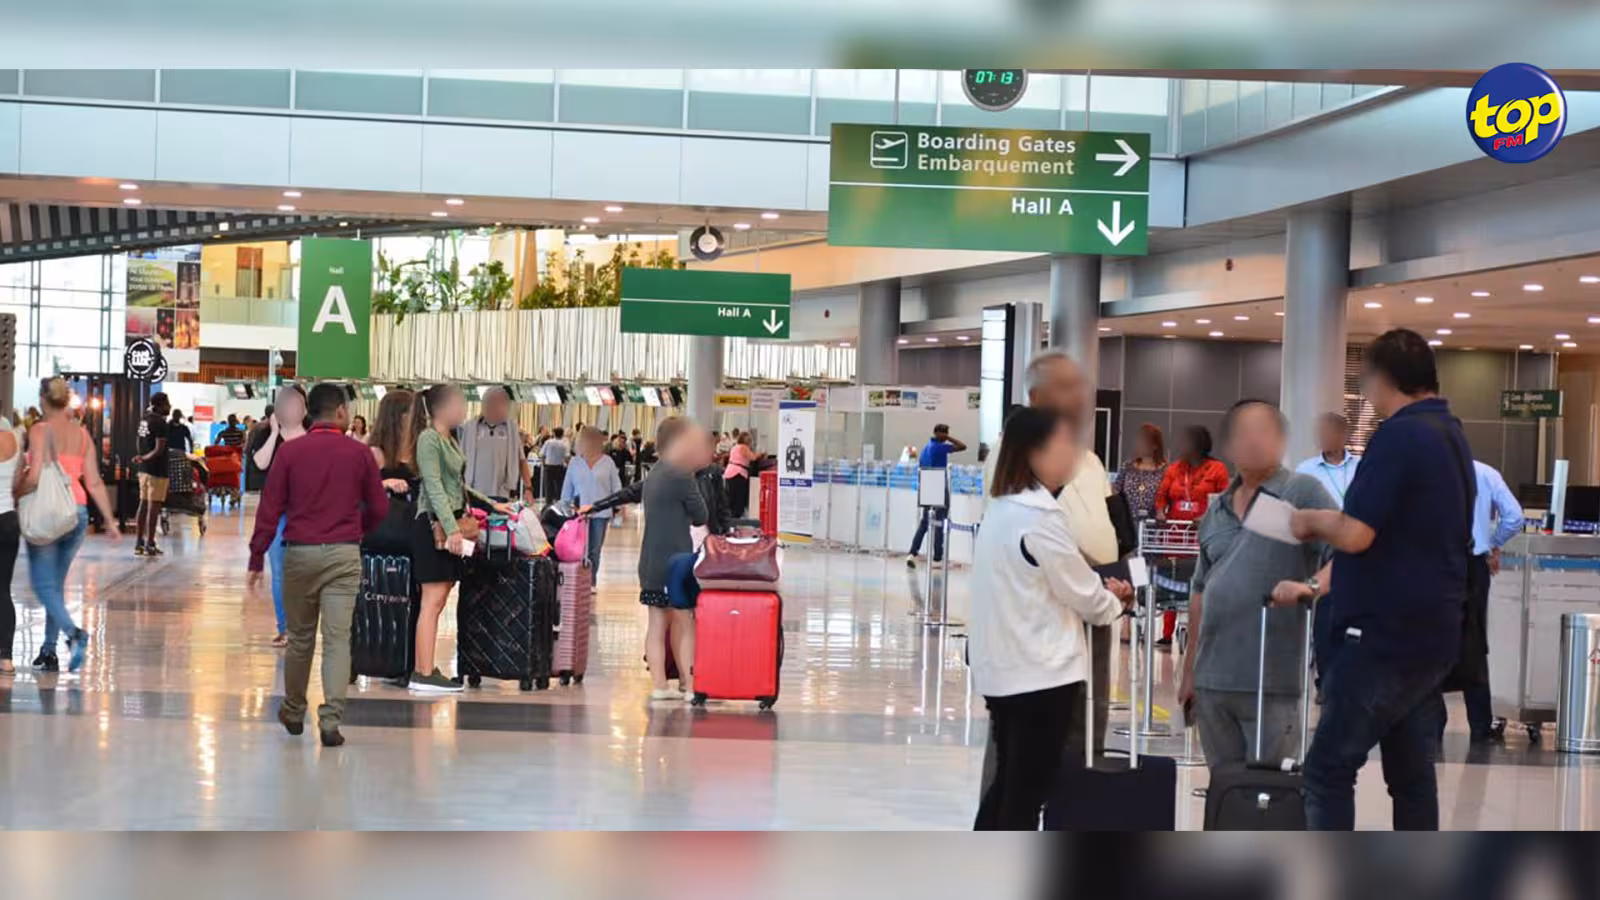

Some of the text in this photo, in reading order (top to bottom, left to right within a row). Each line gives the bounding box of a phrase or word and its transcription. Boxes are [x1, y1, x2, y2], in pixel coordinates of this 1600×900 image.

[975, 70, 1014, 85] 07:13
[917, 132, 1076, 155] Boarding Gates
[917, 153, 1075, 176] Embarquement
[1011, 196, 1074, 216] Hall A
[311, 285, 357, 335] A
[717, 307, 752, 318] Hall A
